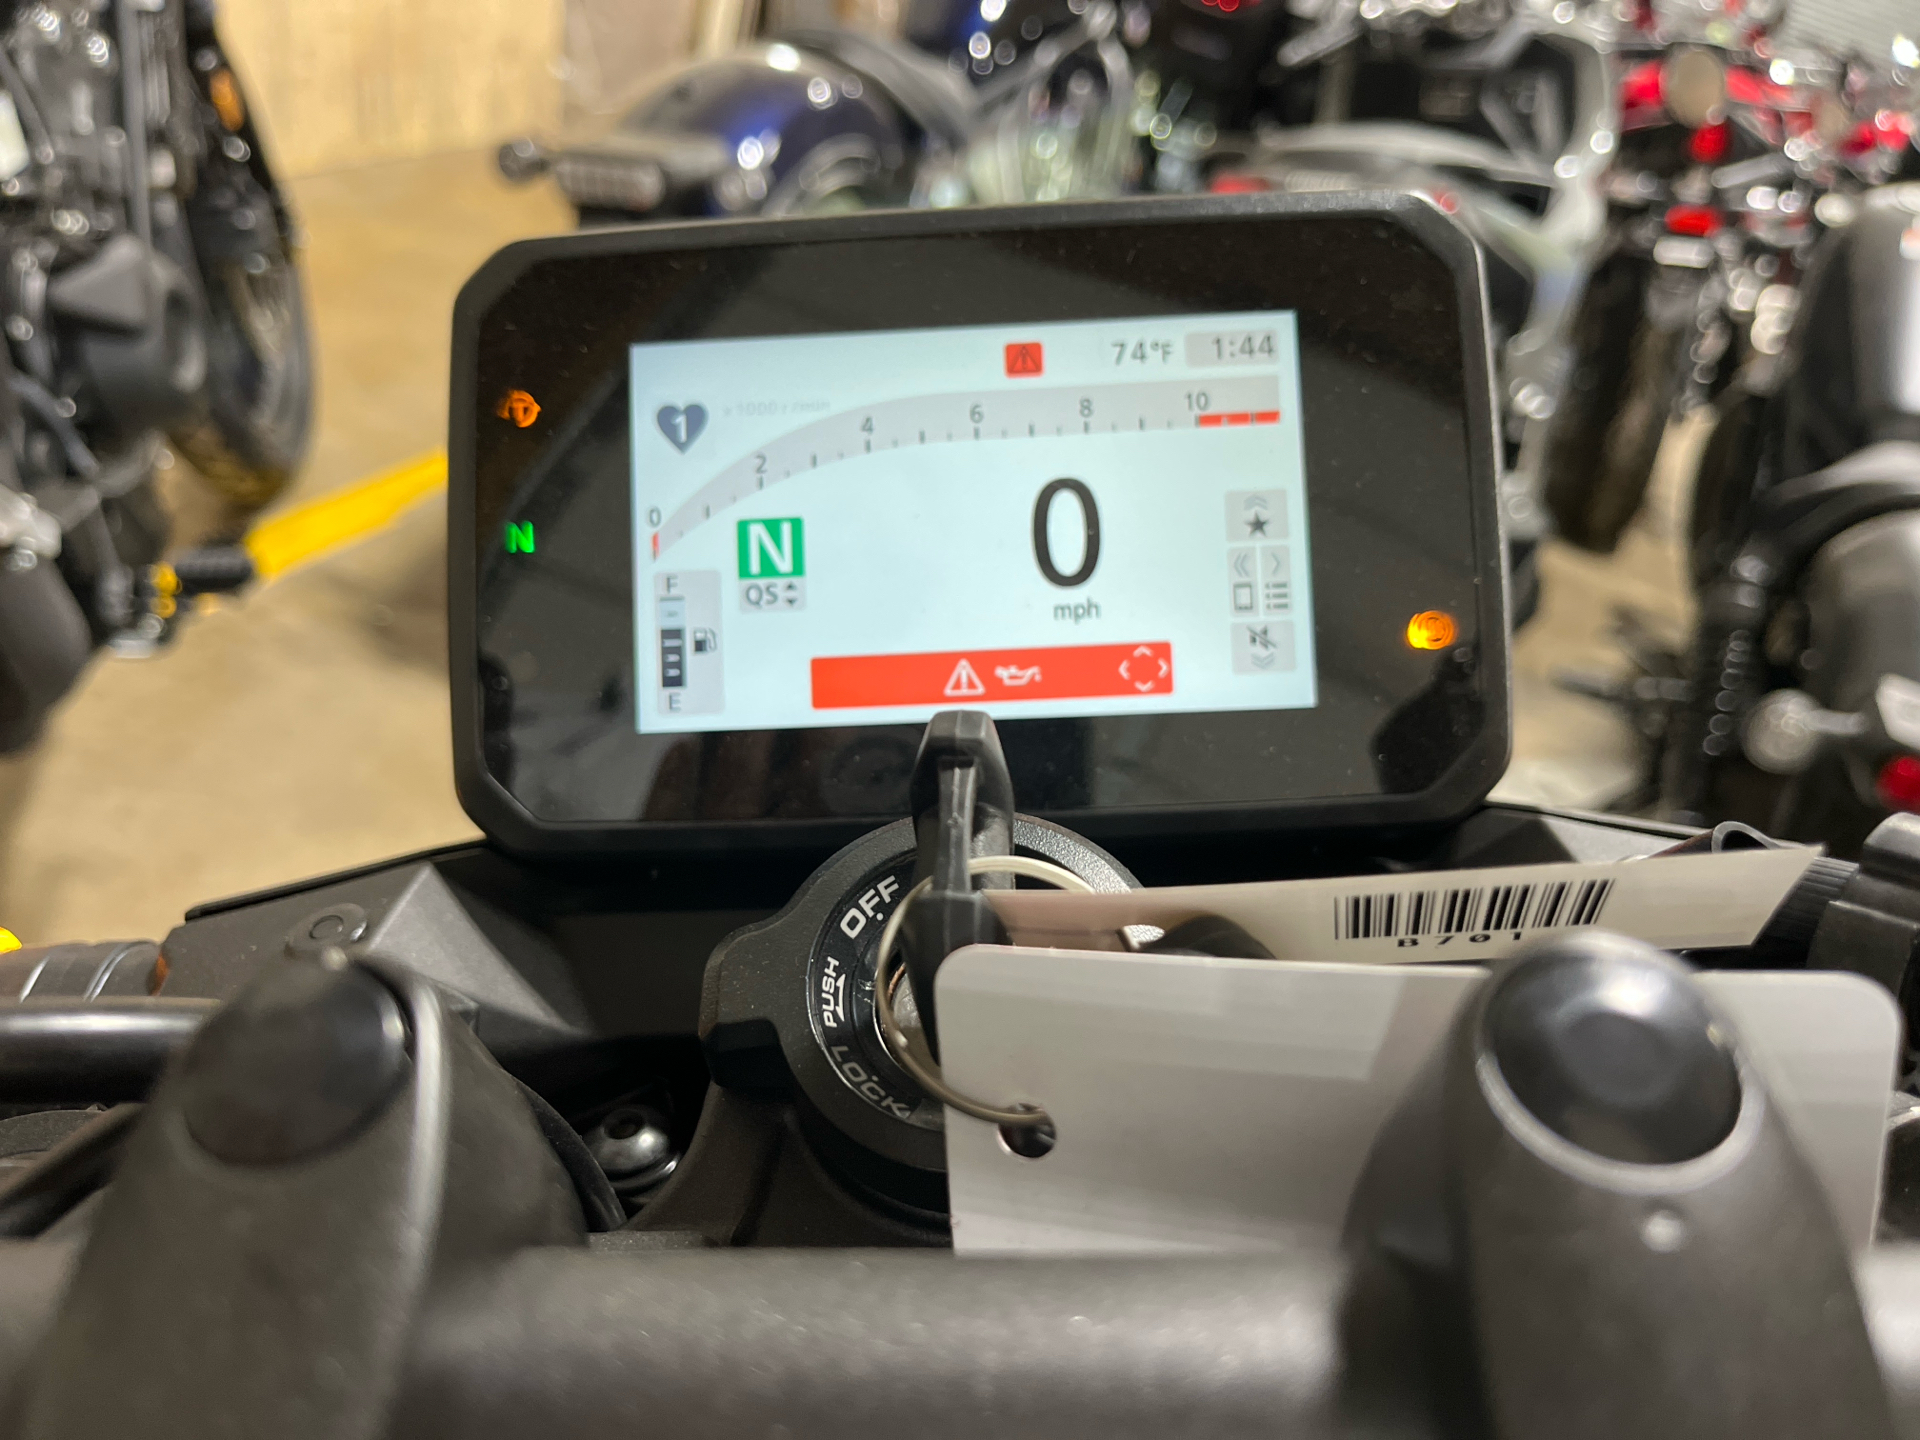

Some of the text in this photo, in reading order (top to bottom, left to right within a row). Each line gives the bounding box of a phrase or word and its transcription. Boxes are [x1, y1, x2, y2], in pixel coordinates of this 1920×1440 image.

[1112, 338, 1175, 365] 74°F
[1212, 334, 1275, 359] 1:44
[736, 400, 778, 416] 1000
[672, 414, 688, 443] 1
[649, 392, 1210, 527] 0 2 4 6 8 10
[505, 521, 535, 553] N
[1032, 477, 1100, 588] 0
[747, 521, 793, 575] N
[665, 575, 678, 594] F
[745, 584, 778, 608] QS
[1053, 597, 1101, 624] mph
[668, 692, 681, 712] E
[839, 875, 899, 939] OFF
[1397, 931, 1523, 948] B701
[821, 956, 840, 1028] PUSH
[830, 1045, 910, 1118] LOCK
